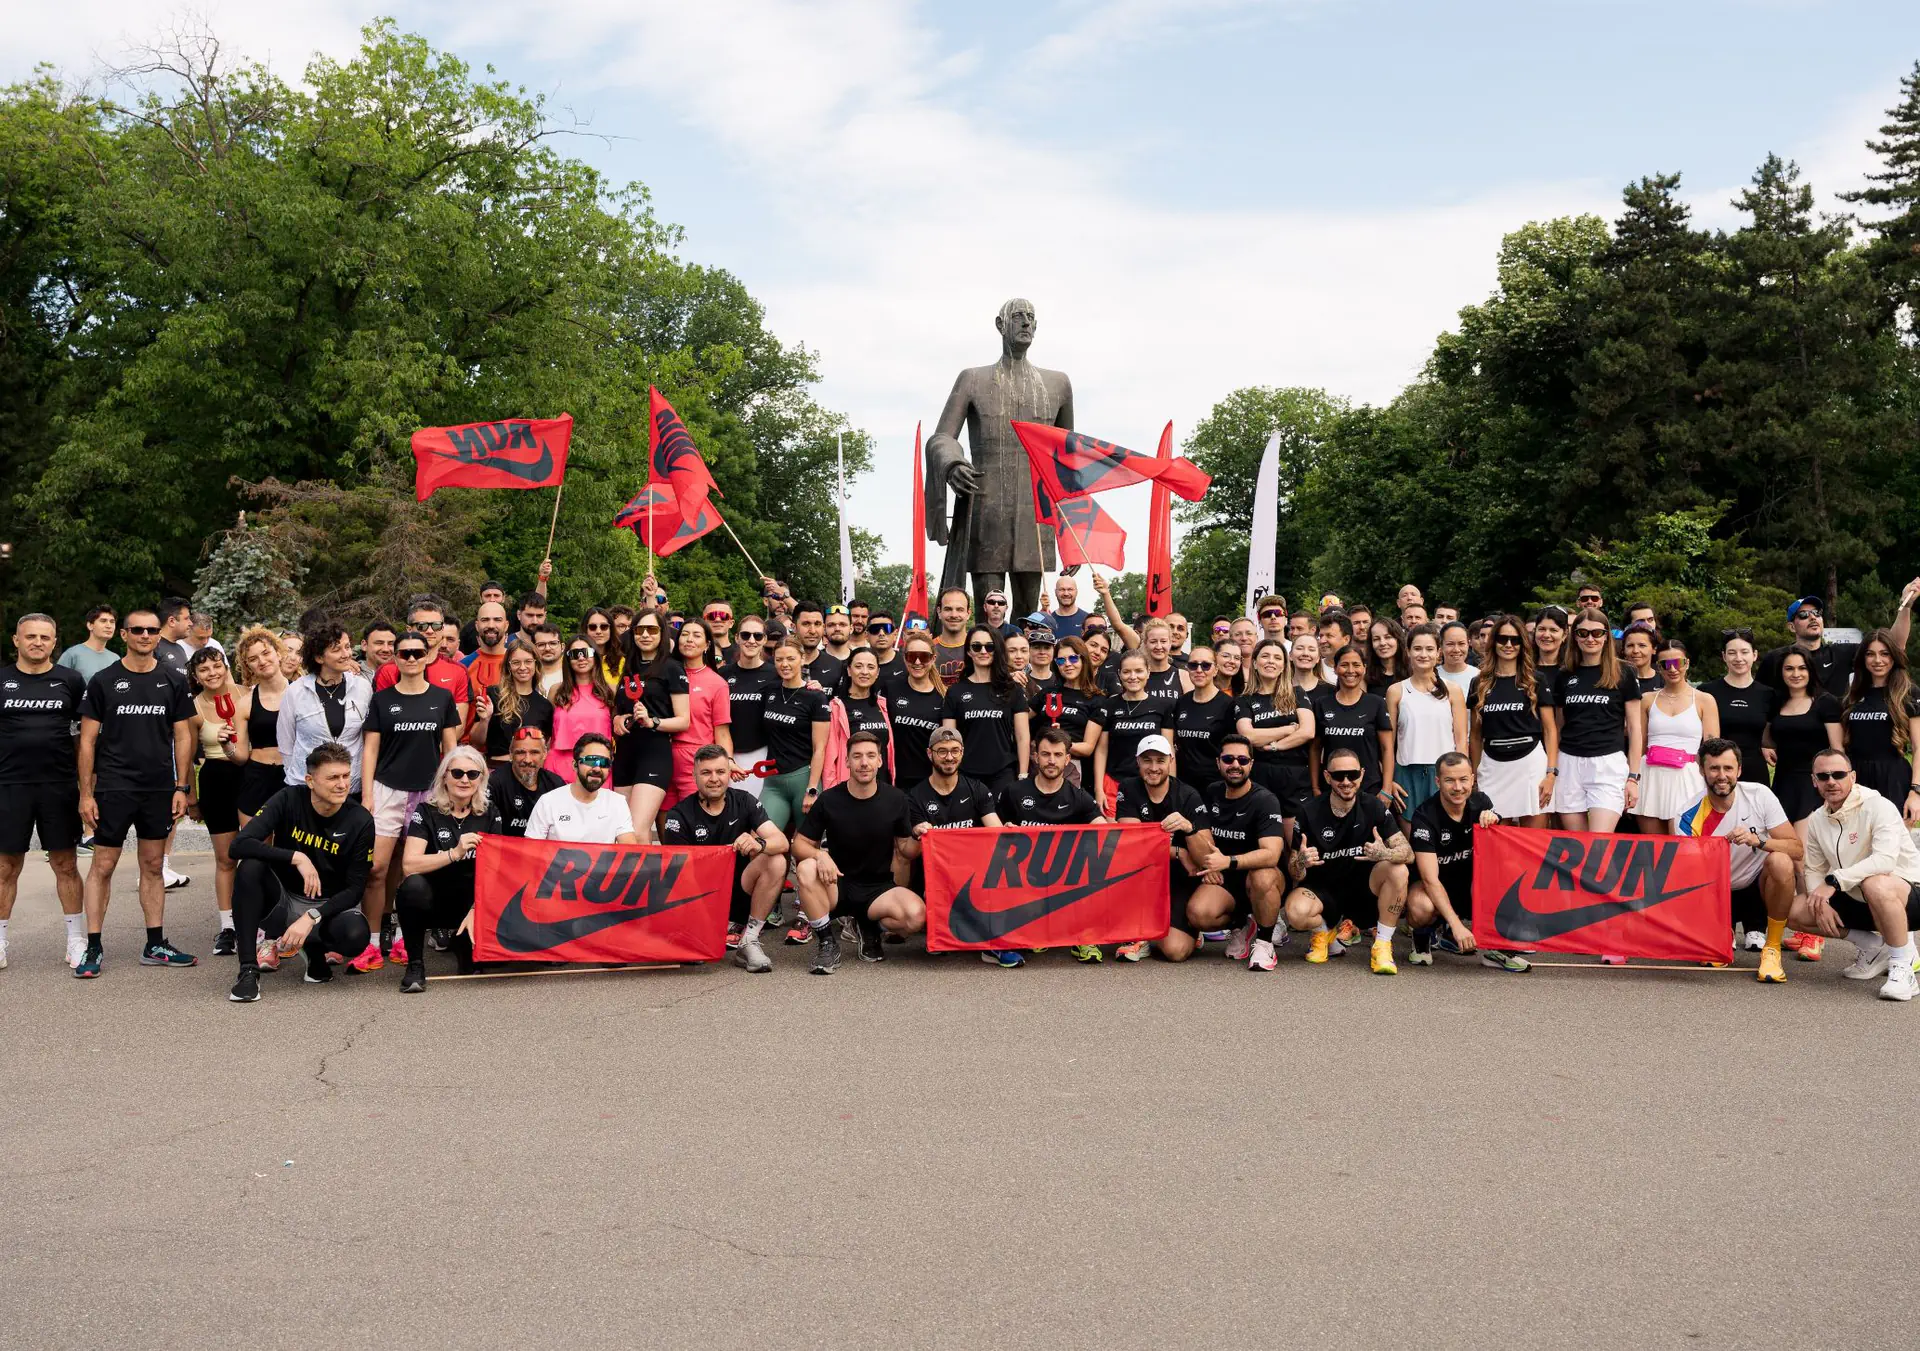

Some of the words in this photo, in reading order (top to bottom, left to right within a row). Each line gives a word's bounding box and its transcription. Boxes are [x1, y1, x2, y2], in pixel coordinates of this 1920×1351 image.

[729, 693, 762, 701] UNNER
[1151, 689, 1179, 699] NNER
[5, 699, 63, 709] RUNNER
[1565, 695, 1610, 704] RUNNER
[116, 704, 166, 715] RUNNER
[1484, 703, 1525, 712] RUNNER
[965, 709, 1004, 719] RUNNER
[1848, 712, 1888, 721] RUNNER
[394, 722, 437, 732] RUNNER
[1115, 721, 1156, 730] RUNNER
[1324, 727, 1365, 736] RUNNER
[982, 829, 1123, 889] RUN
[1532, 837, 1680, 898] RUN
[535, 848, 688, 907] RUN
